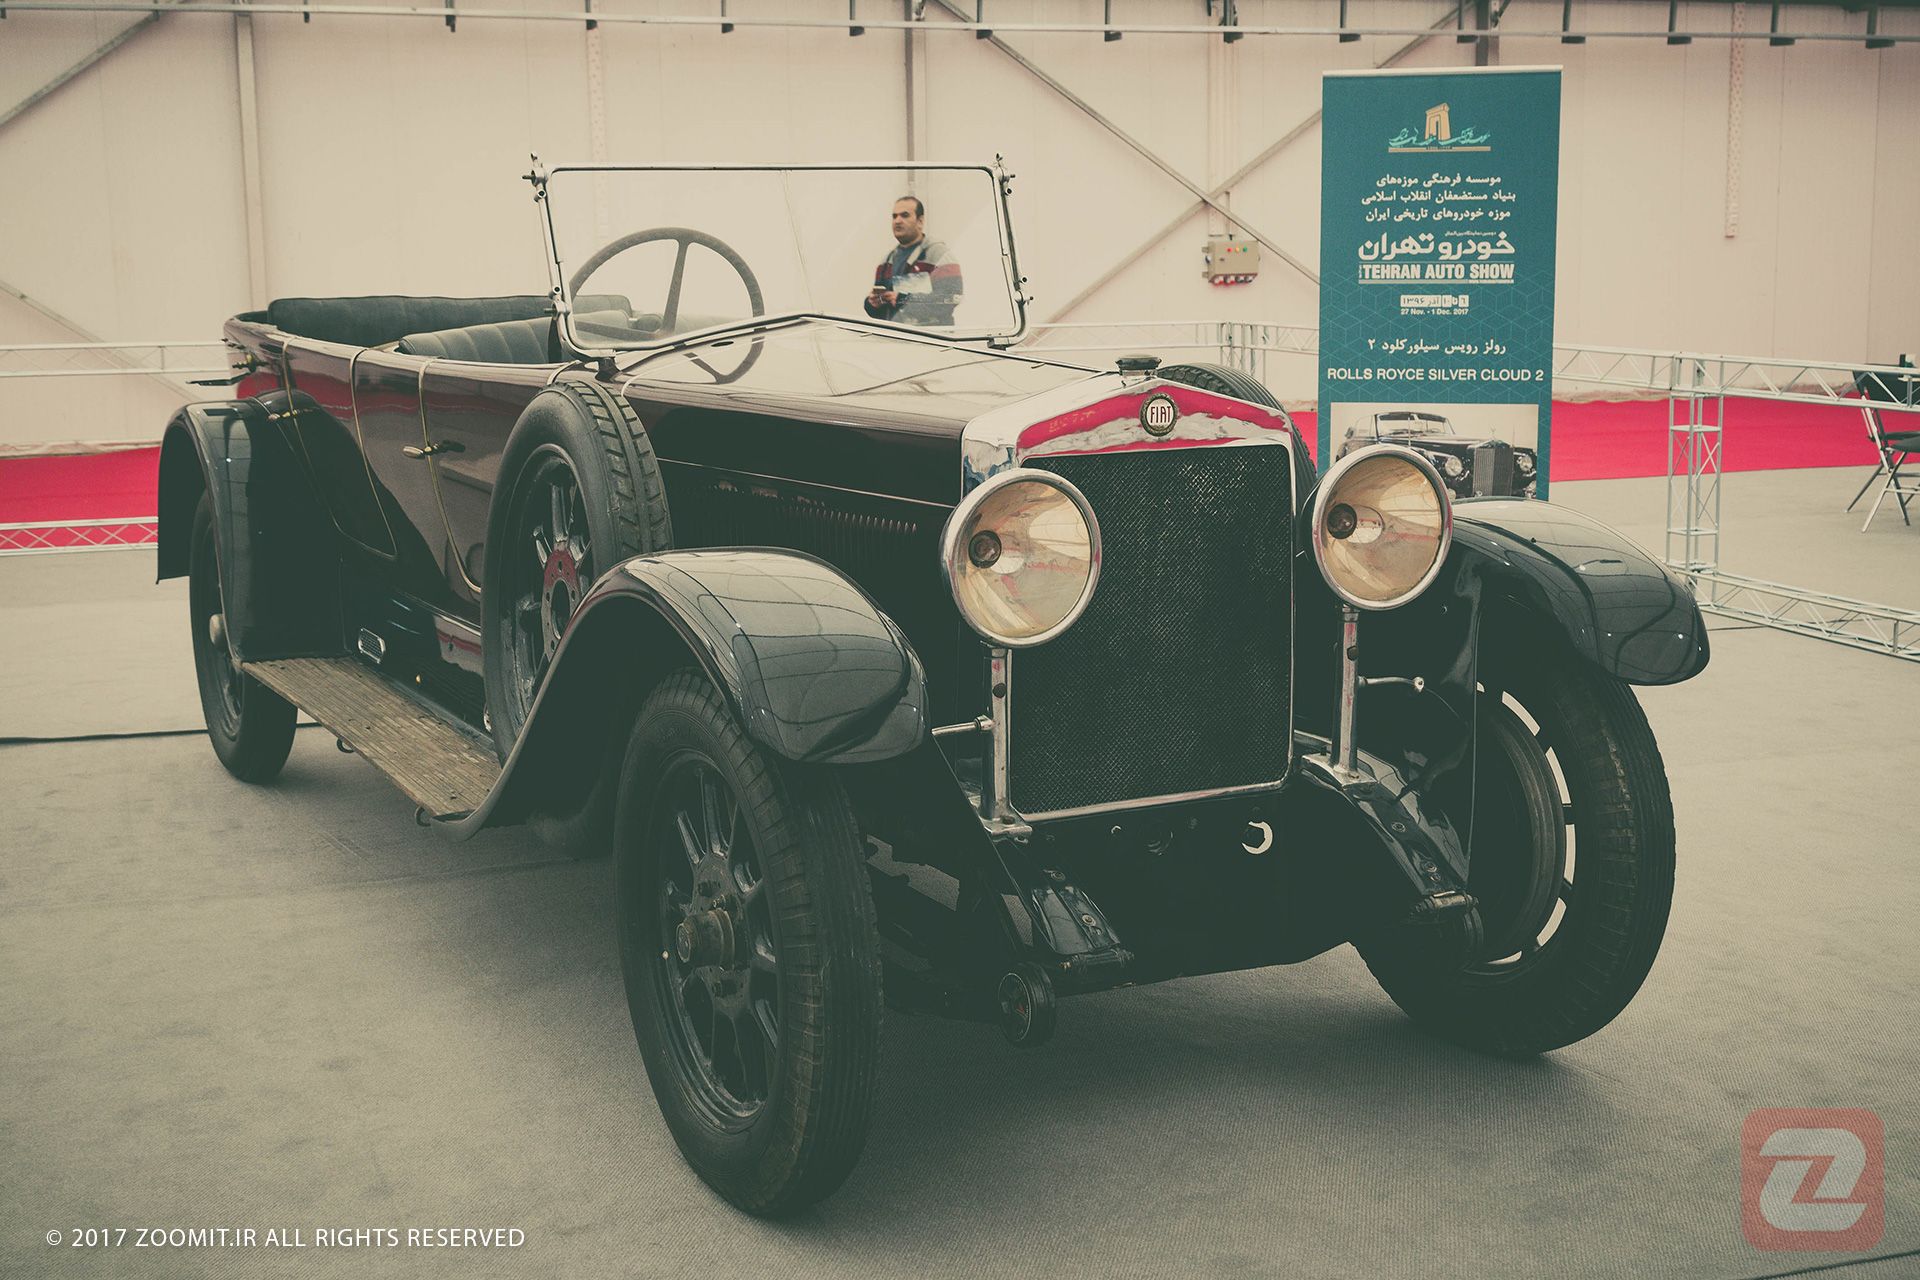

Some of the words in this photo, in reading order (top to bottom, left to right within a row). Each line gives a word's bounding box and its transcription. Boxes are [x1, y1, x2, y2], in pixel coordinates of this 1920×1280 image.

[1423, 173, 1461, 188] فرهنگی
[1466, 176, 1501, 187] موسسه
[1361, 191, 1396, 205] اسلامی
[1401, 190, 1431, 203] انقلاب
[1435, 190, 1488, 204] مستضعفان
[1492, 190, 1516, 202] بنیاد
[1365, 208, 1390, 222] ایران
[1394, 208, 1428, 222] تاریخی
[1432, 207, 1484, 220] خودروهای
[1488, 211, 1511, 220] موزه
[1358, 232, 1435, 260] تهران
[1438, 231, 1515, 260] خودرو
[1363, 264, 1420, 279] TEHRAN
[1425, 264, 1464, 279] AUTO
[1470, 264, 1515, 279] SHOW
[1445, 341, 1478, 355] رویس
[1483, 339, 1506, 355] رولز
[1327, 368, 1372, 380] ROLLS
[1377, 368, 1424, 381] ROYCE
[1428, 368, 1477, 381] SILVER
[1480, 369, 1531, 382] CLOUD
[1535, 369, 1544, 382] 2
[1150, 406, 1171, 423] FIAT
